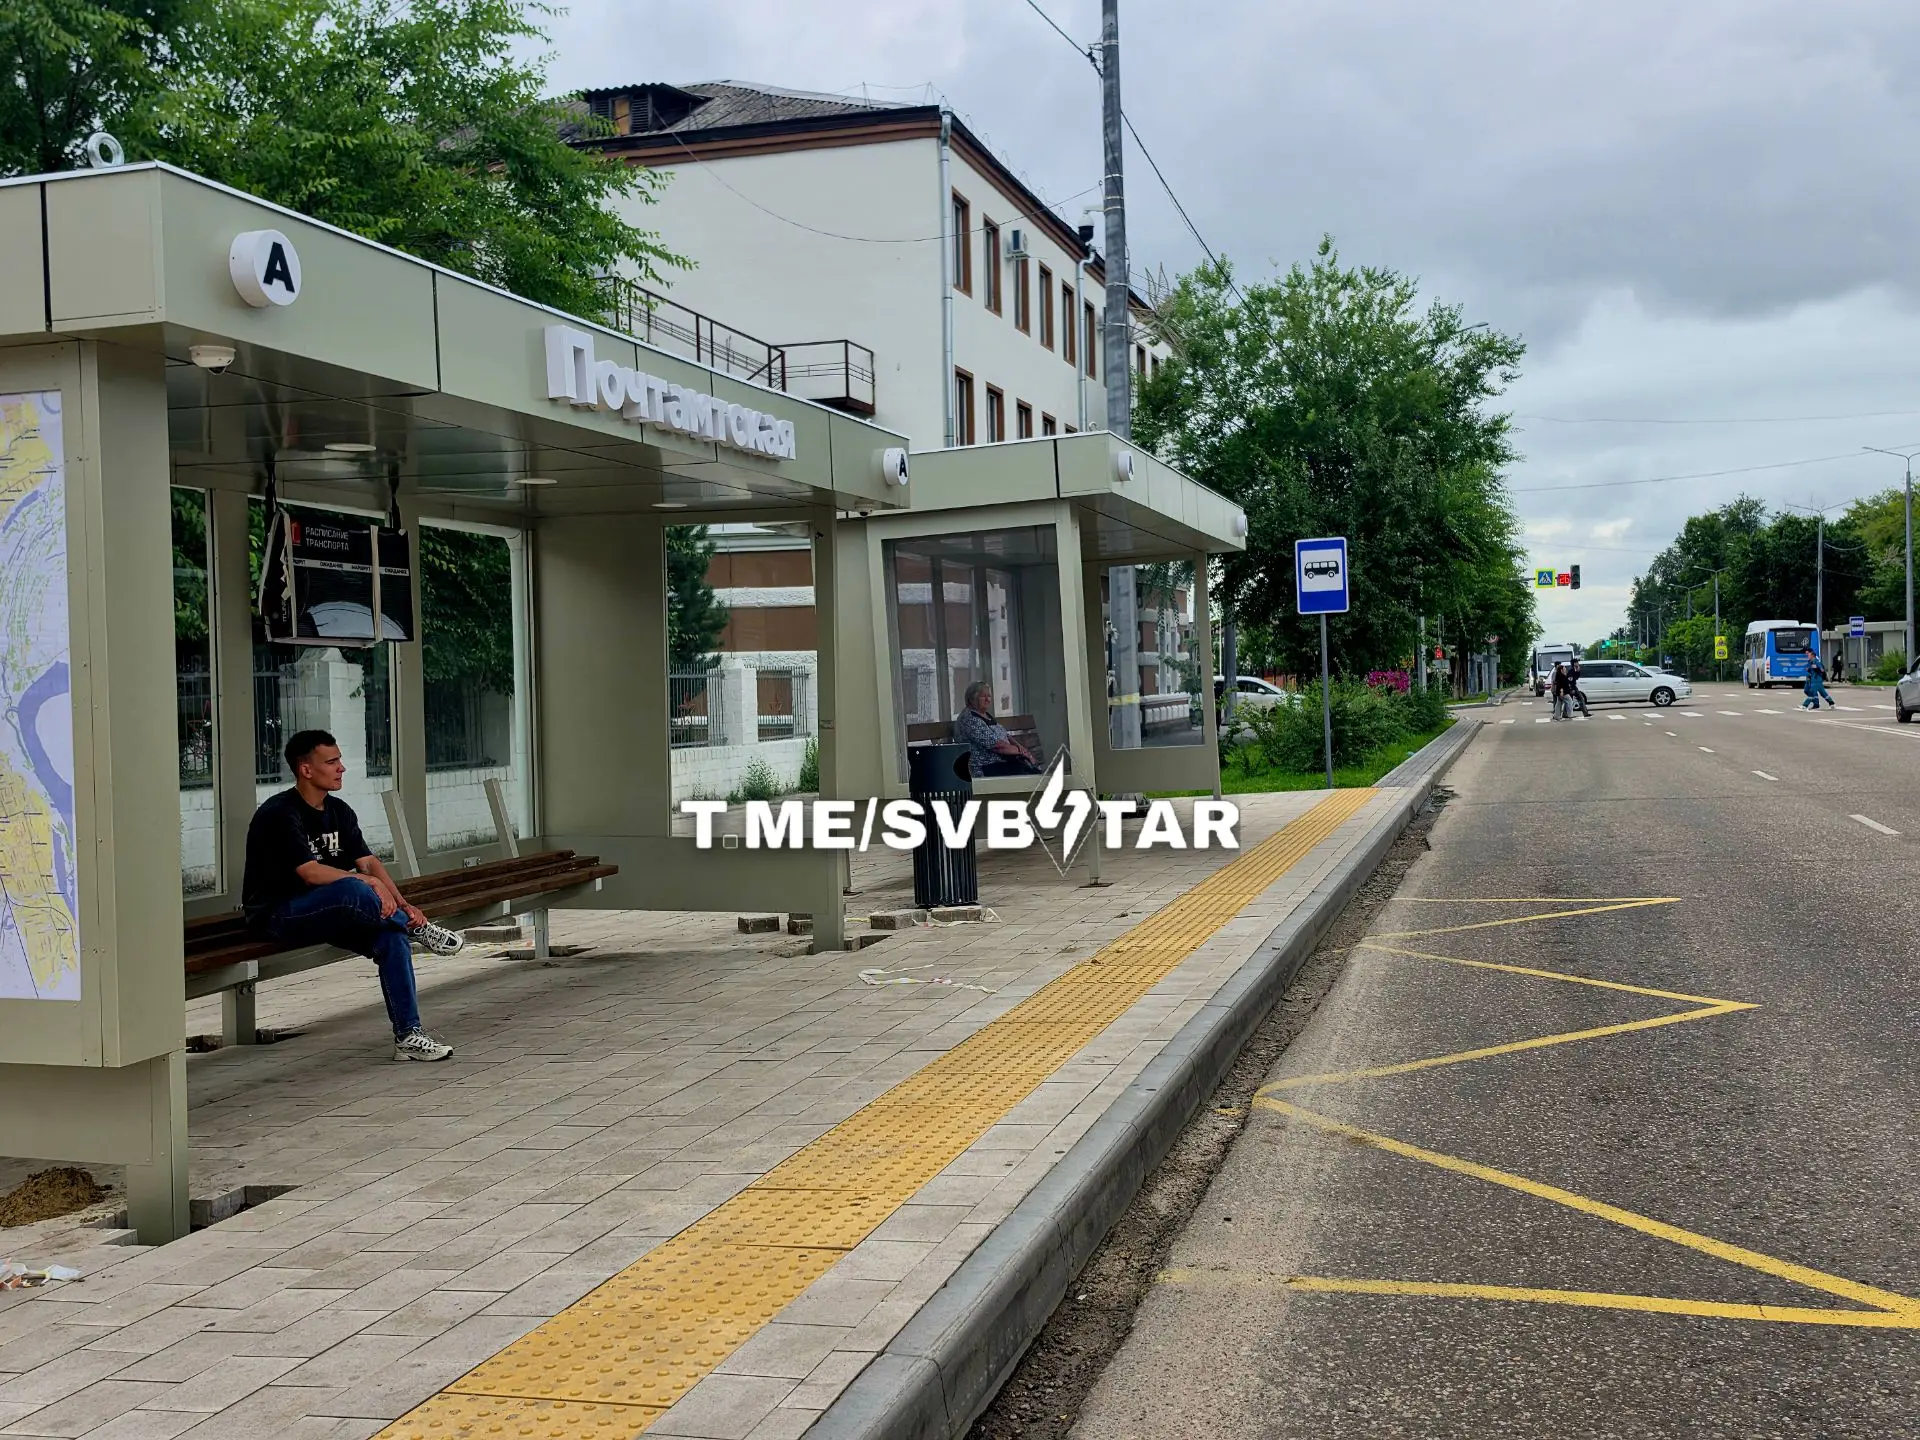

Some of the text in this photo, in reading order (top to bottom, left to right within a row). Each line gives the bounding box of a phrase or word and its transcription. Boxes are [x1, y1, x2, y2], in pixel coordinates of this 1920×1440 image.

[263, 241, 295, 293] А
[545, 326, 796, 461] Почтамтская
[899, 453, 908, 478] А
[305, 527, 349, 539] РАСПИСАНИЕ
[306, 538, 349, 550] ТРАНСПОРТА
